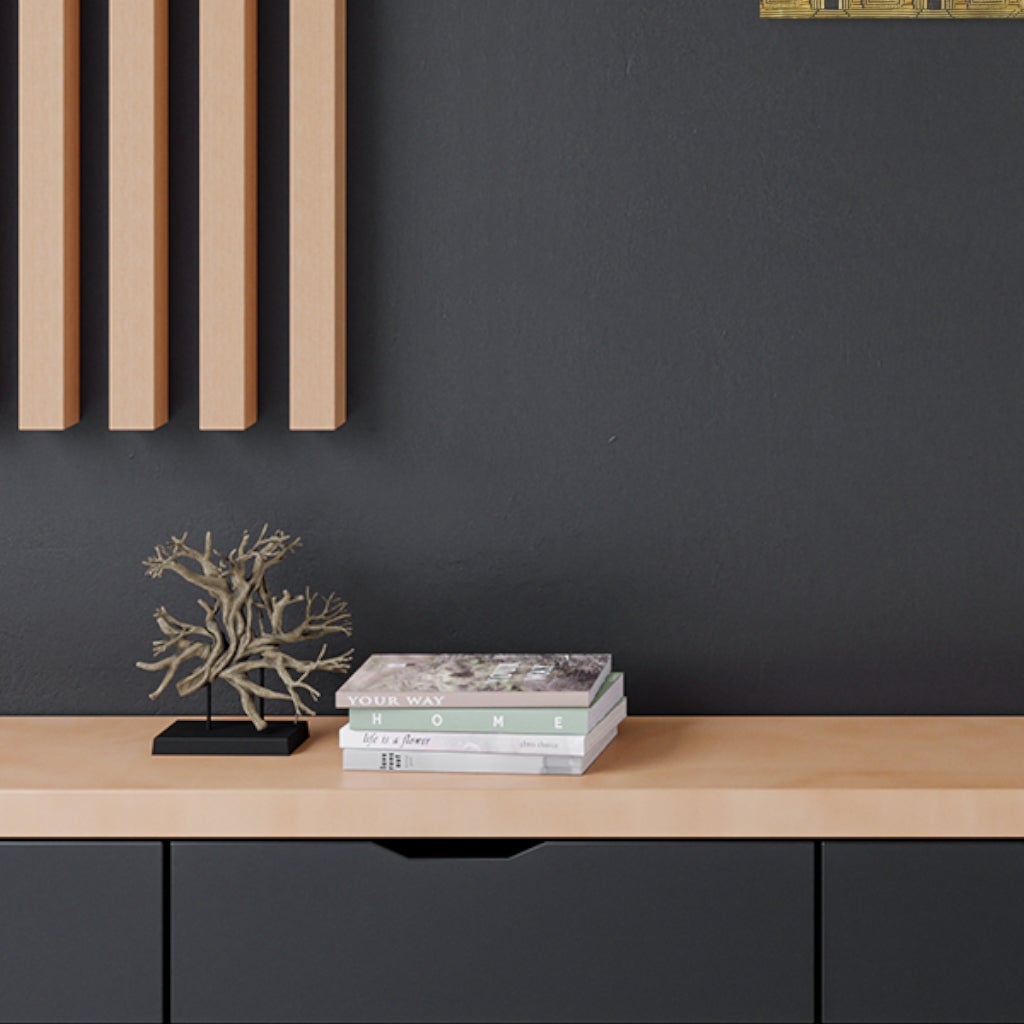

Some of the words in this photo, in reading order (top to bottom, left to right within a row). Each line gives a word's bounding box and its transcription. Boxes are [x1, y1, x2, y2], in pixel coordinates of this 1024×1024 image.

[348, 695, 400, 706] YOUR
[406, 695, 445, 706] WAY
[362, 732, 378, 747] life
[392, 736, 398, 744] a
[401, 734, 432, 748] flower
